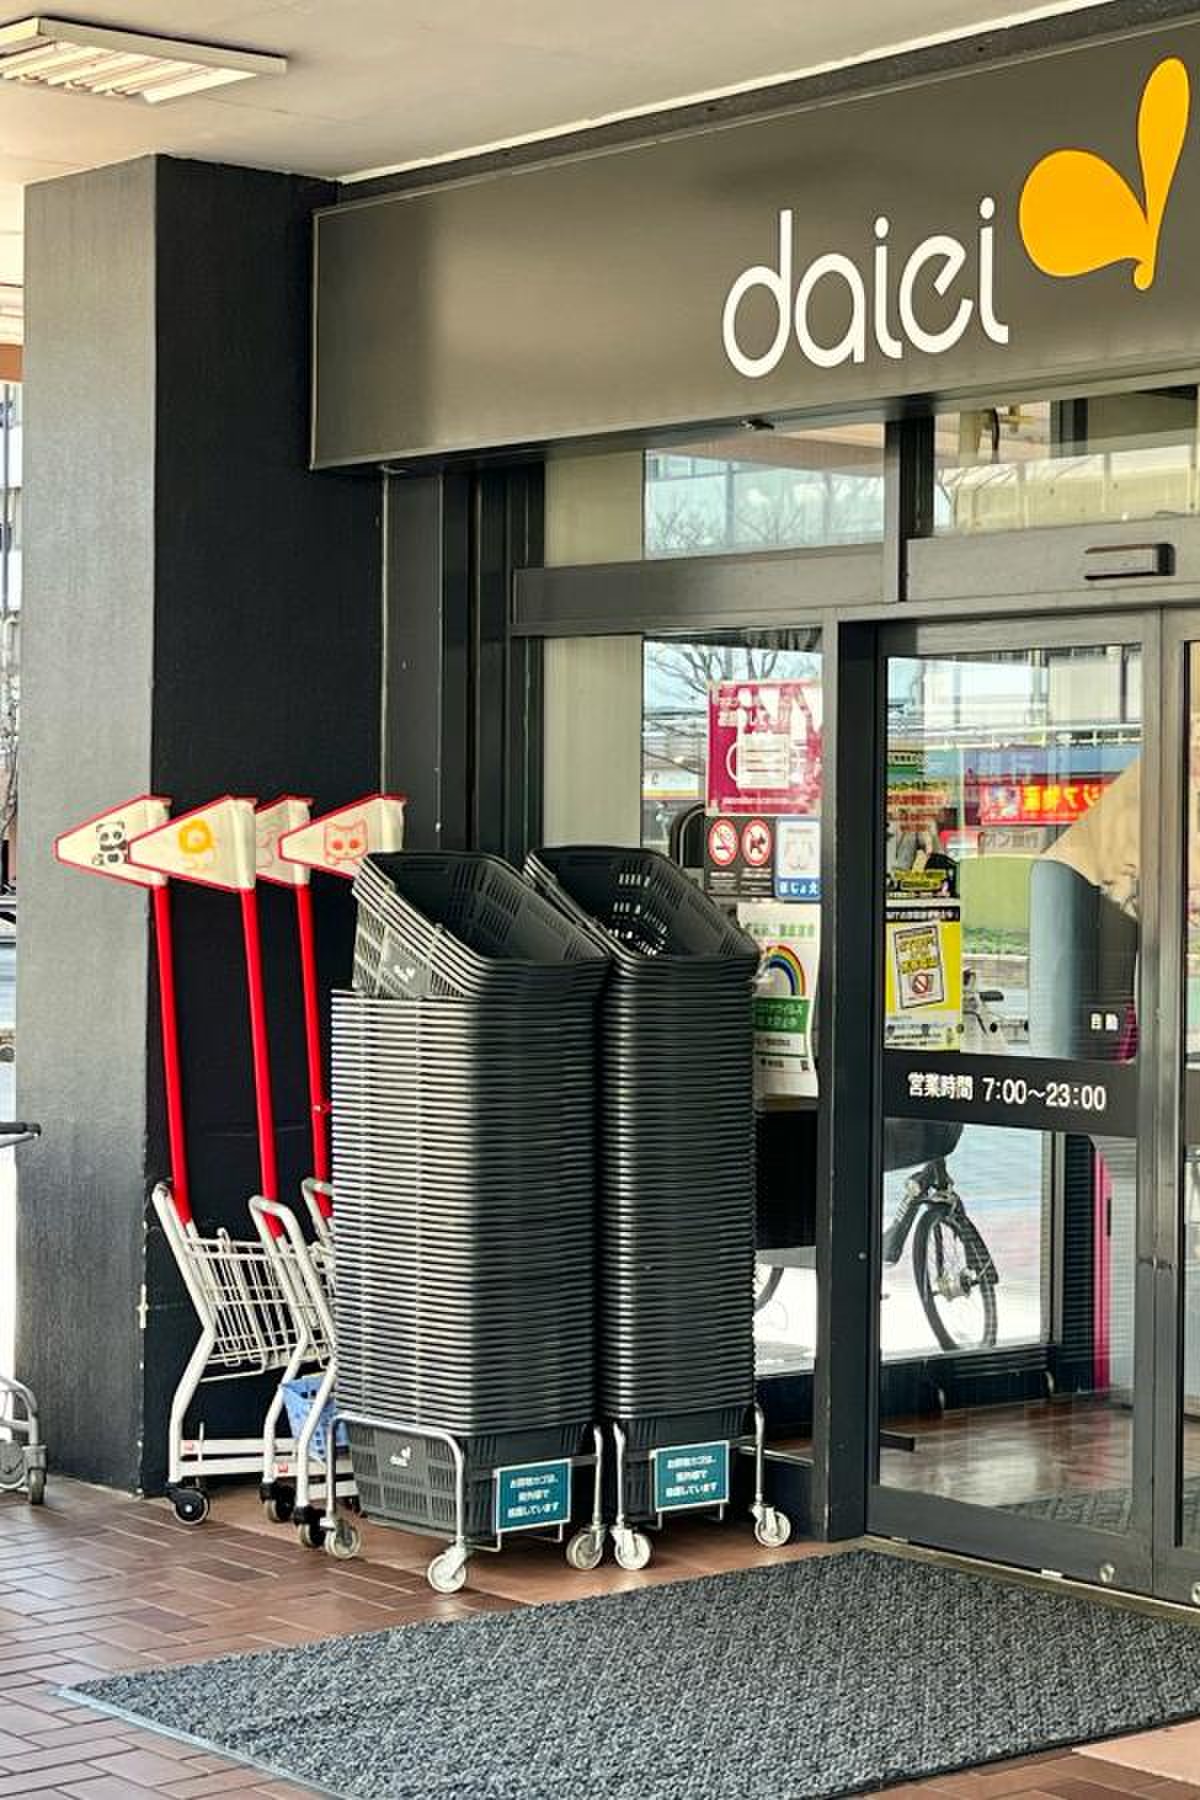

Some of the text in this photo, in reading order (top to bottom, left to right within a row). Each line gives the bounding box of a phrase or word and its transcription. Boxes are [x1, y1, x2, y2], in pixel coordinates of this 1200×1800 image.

[722, 196, 1009, 378] daiei
[1090, 1012, 1119, 1032] 自動
[907, 1072, 974, 1102] 営業時間
